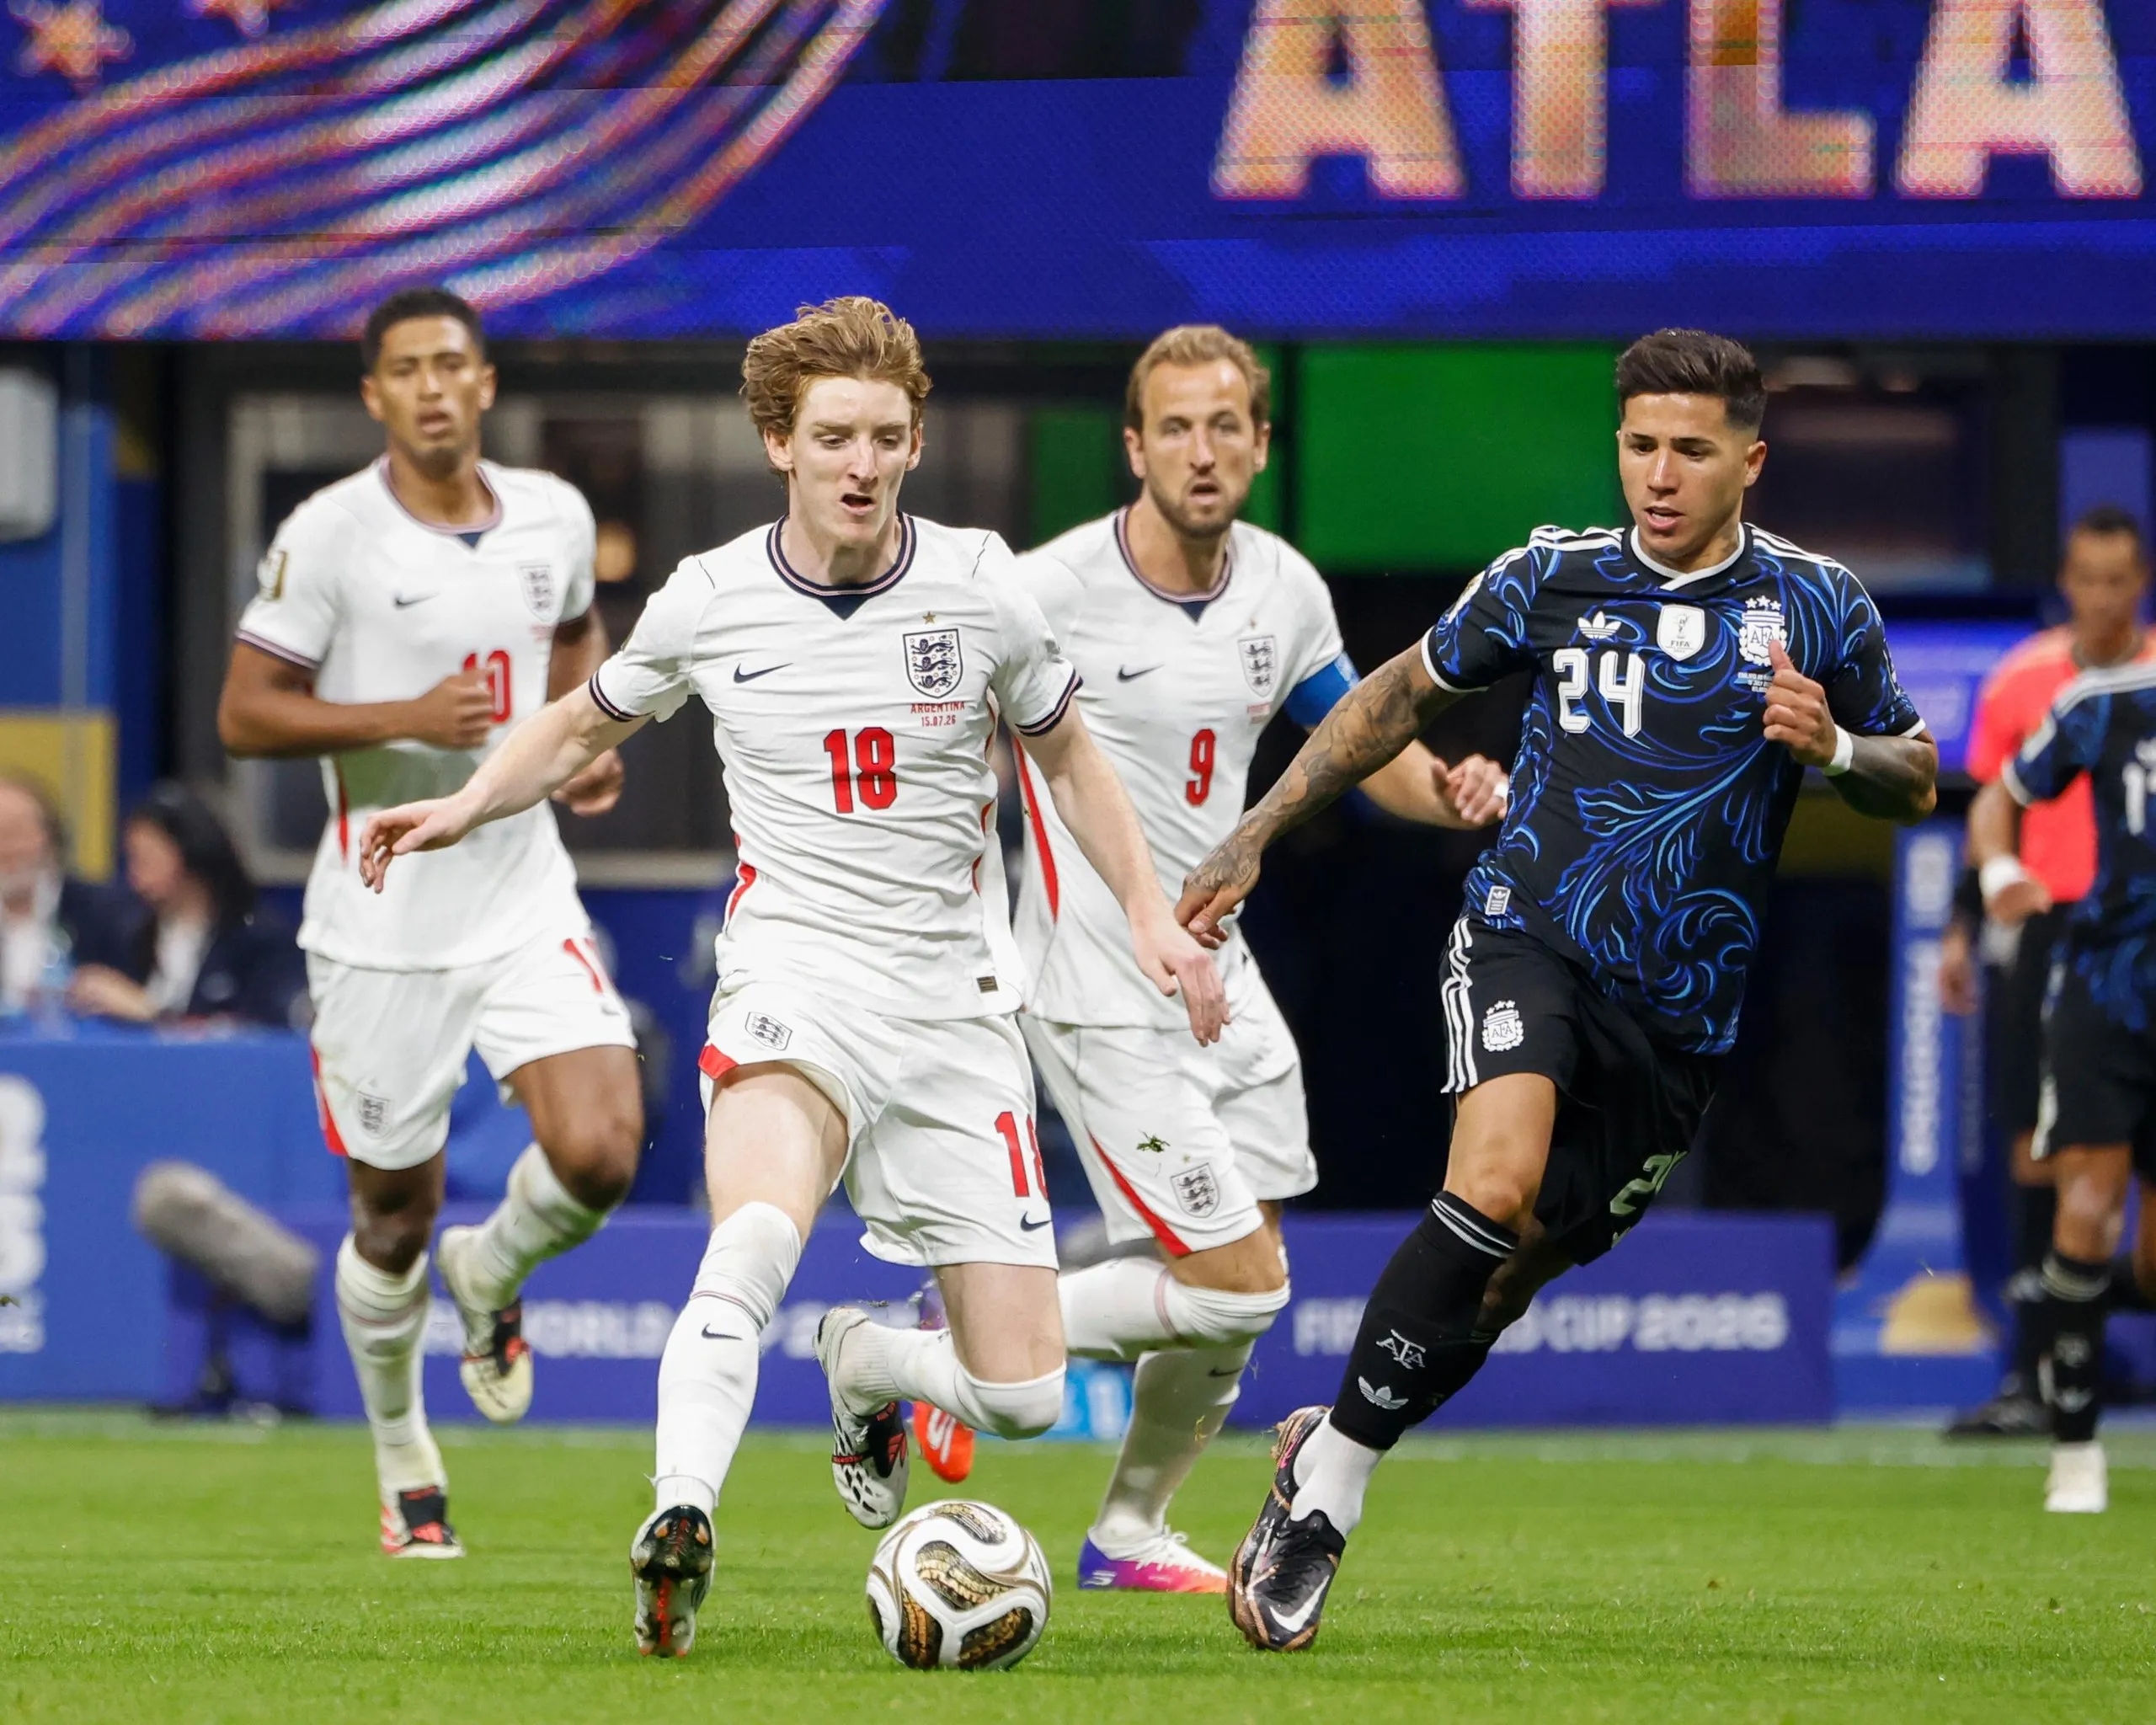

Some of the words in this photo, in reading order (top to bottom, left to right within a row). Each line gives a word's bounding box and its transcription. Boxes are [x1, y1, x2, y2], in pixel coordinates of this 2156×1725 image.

[1209, 0, 2145, 199] ATLA
[910, 701, 965, 713] ARGENTINA
[921, 714, 956, 727] 15.07.26
[1552, 648, 1645, 738] 24
[823, 727, 897, 814] 18
[1186, 729, 1215, 808] 9
[562, 937, 605, 993] 1
[1376, 1329, 1426, 1370] AFA
